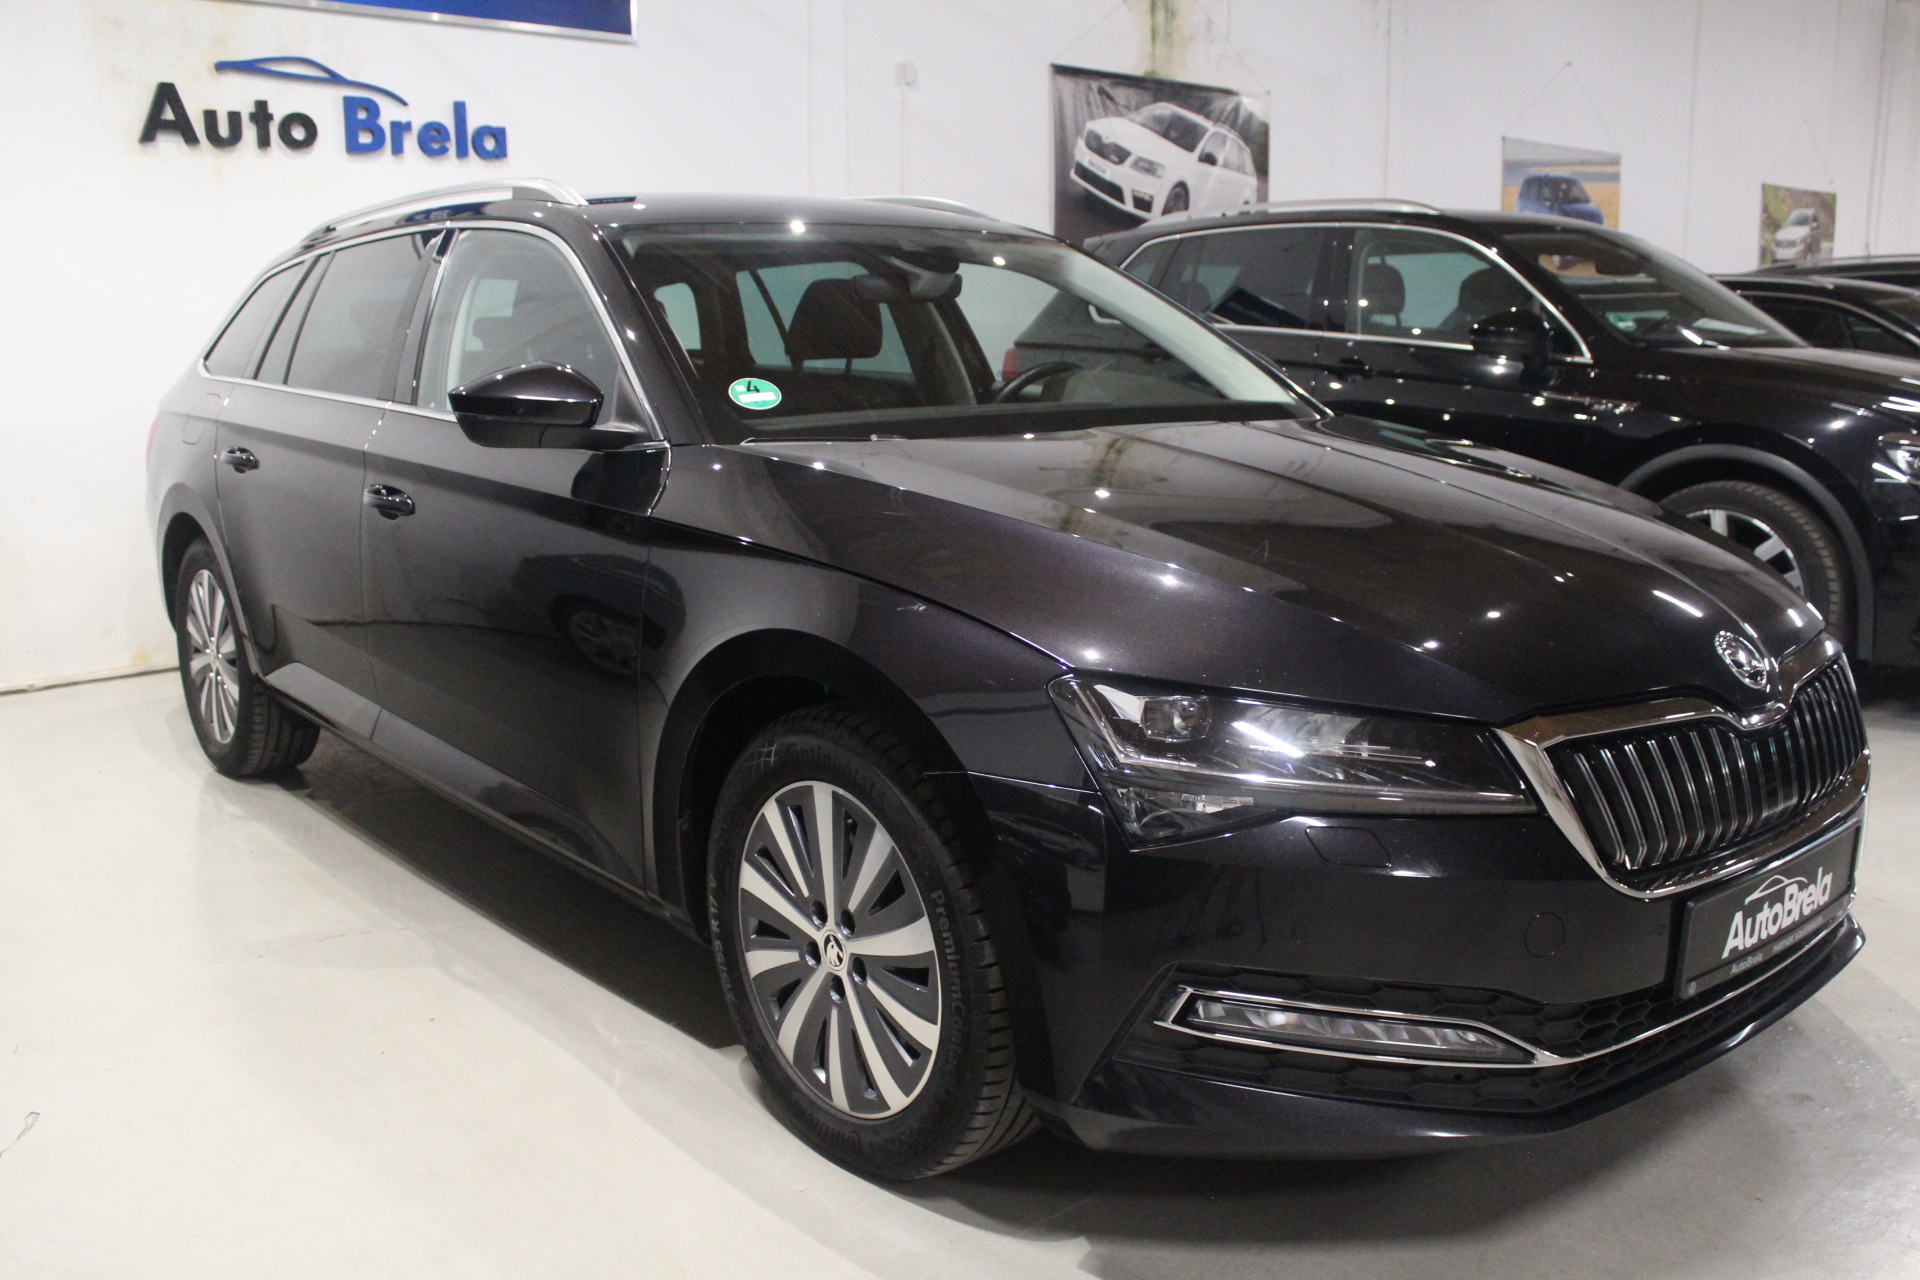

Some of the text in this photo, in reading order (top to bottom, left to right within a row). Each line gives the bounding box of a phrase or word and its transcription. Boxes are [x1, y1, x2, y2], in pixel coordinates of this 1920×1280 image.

[139, 82, 507, 159] Auto Brela
[746, 380, 760, 393] 4
[1721, 866, 1833, 959] AutoBrela
